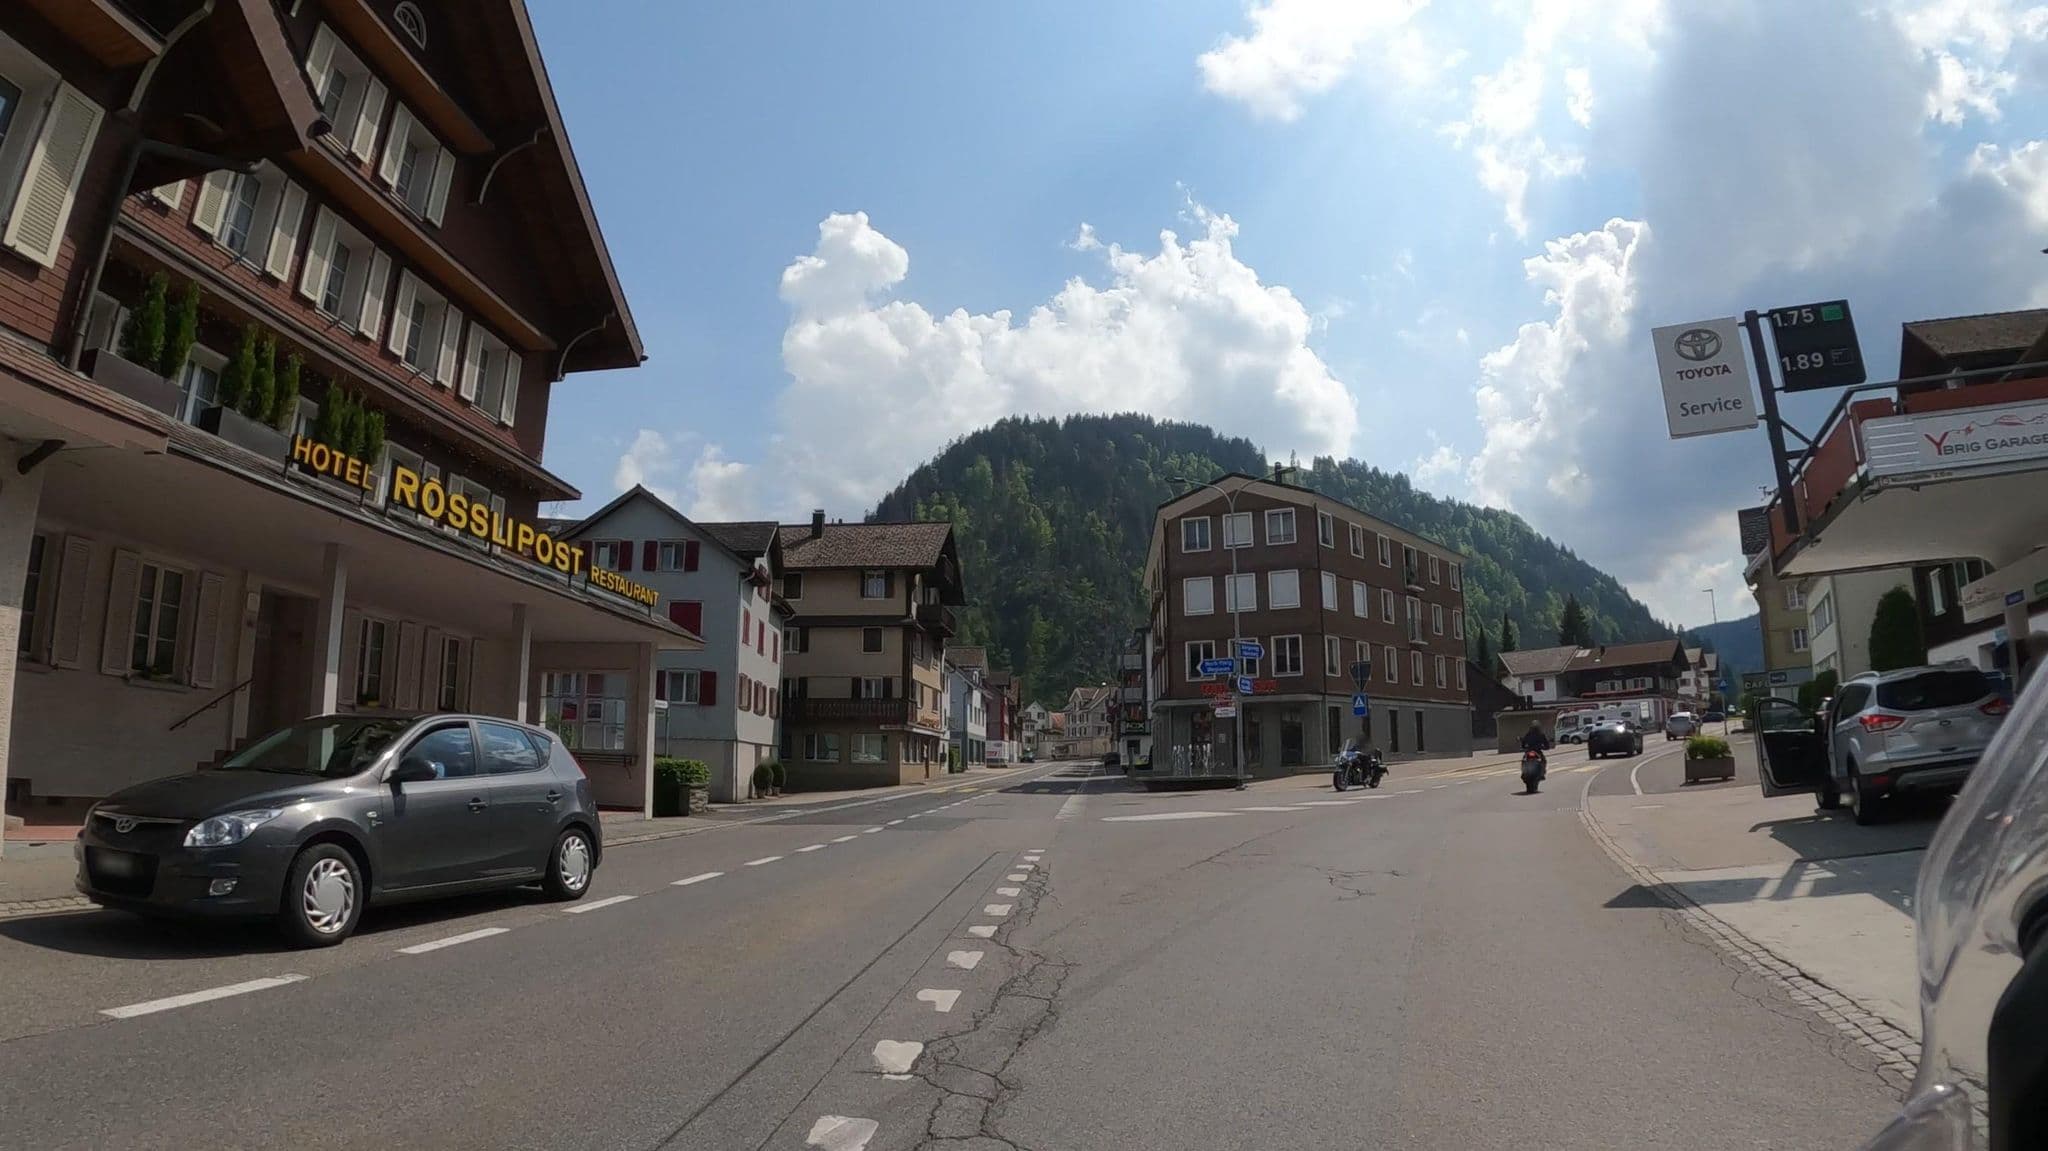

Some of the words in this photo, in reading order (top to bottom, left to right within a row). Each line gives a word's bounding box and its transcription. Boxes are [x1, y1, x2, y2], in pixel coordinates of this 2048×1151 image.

[1773, 308, 1815, 327] 1.75
[1782, 352, 1825, 371] 1.89
[1677, 364, 1732, 381] TOYOTA
[1680, 398, 1743, 417] Service
[1924, 431, 1981, 456] YBRIG
[294, 434, 374, 491] HOTEL
[591, 565, 660, 607] RESTAURANT
